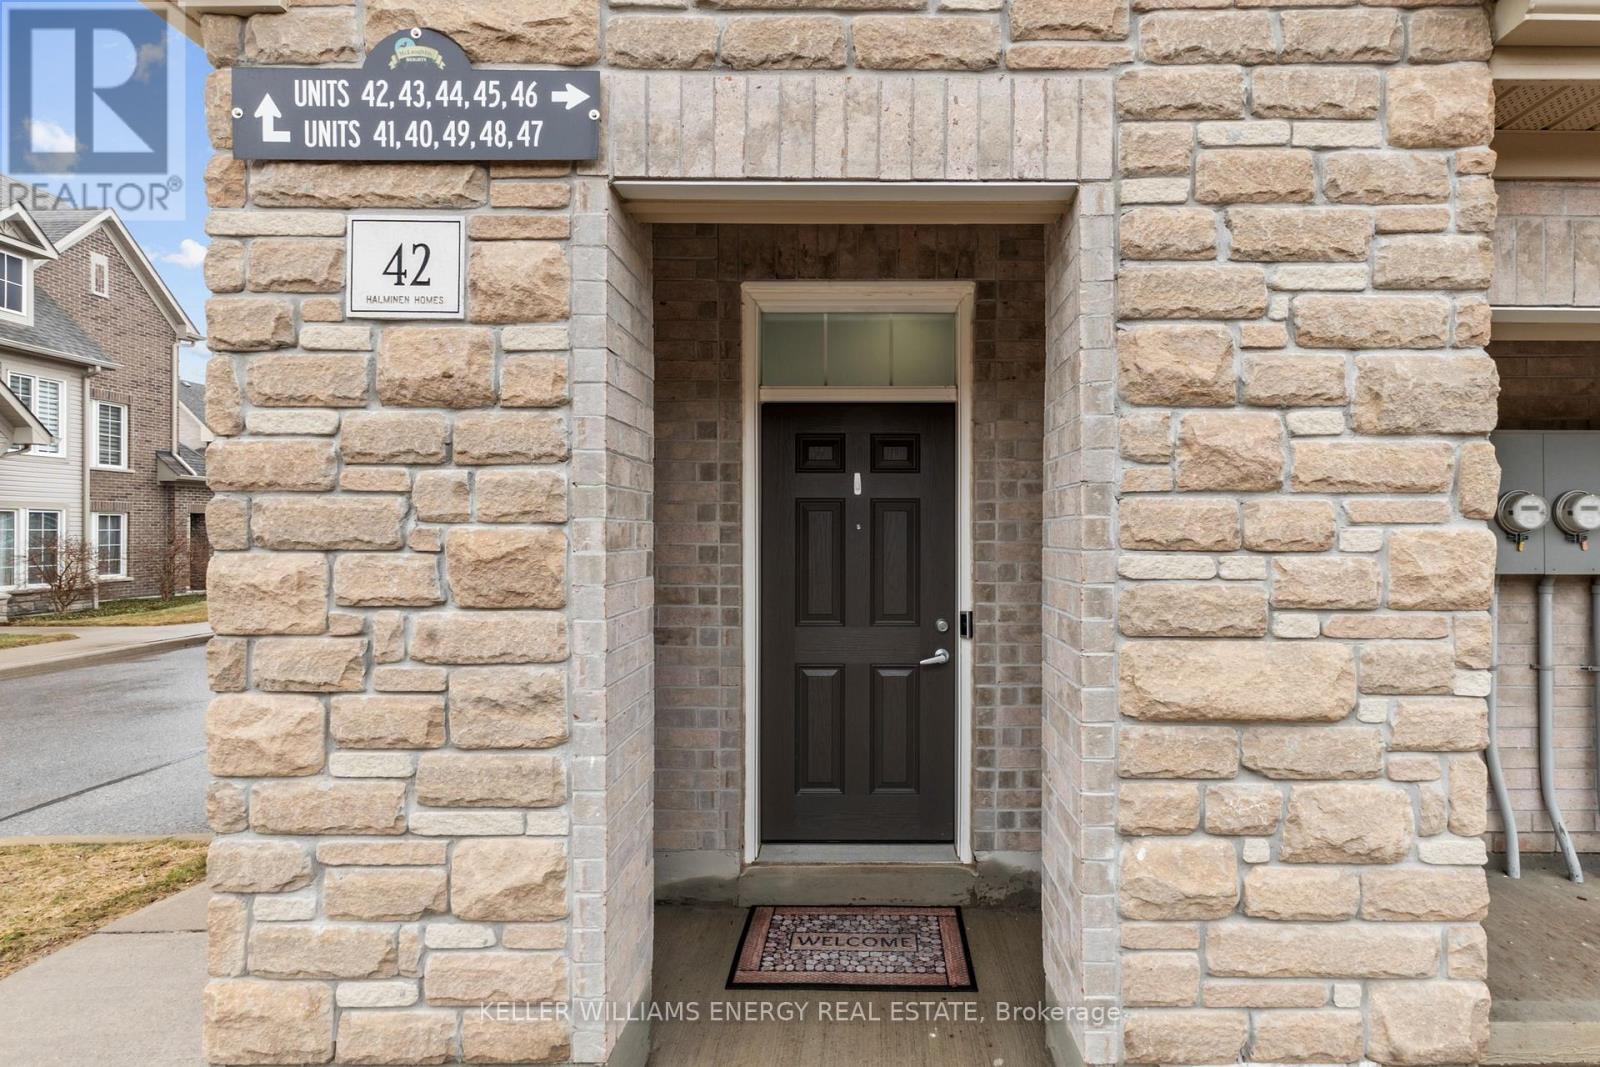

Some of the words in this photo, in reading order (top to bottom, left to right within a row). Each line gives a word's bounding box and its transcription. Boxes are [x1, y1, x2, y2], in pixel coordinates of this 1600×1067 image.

[294, 79, 350, 108] UNITS
[304, 119, 361, 149] UNITS
[382, 242, 431, 287] 42
[366, 295, 410, 305] HALMINEN
[414, 295, 444, 305] HOMES
[798, 936, 913, 948] WELCOME
